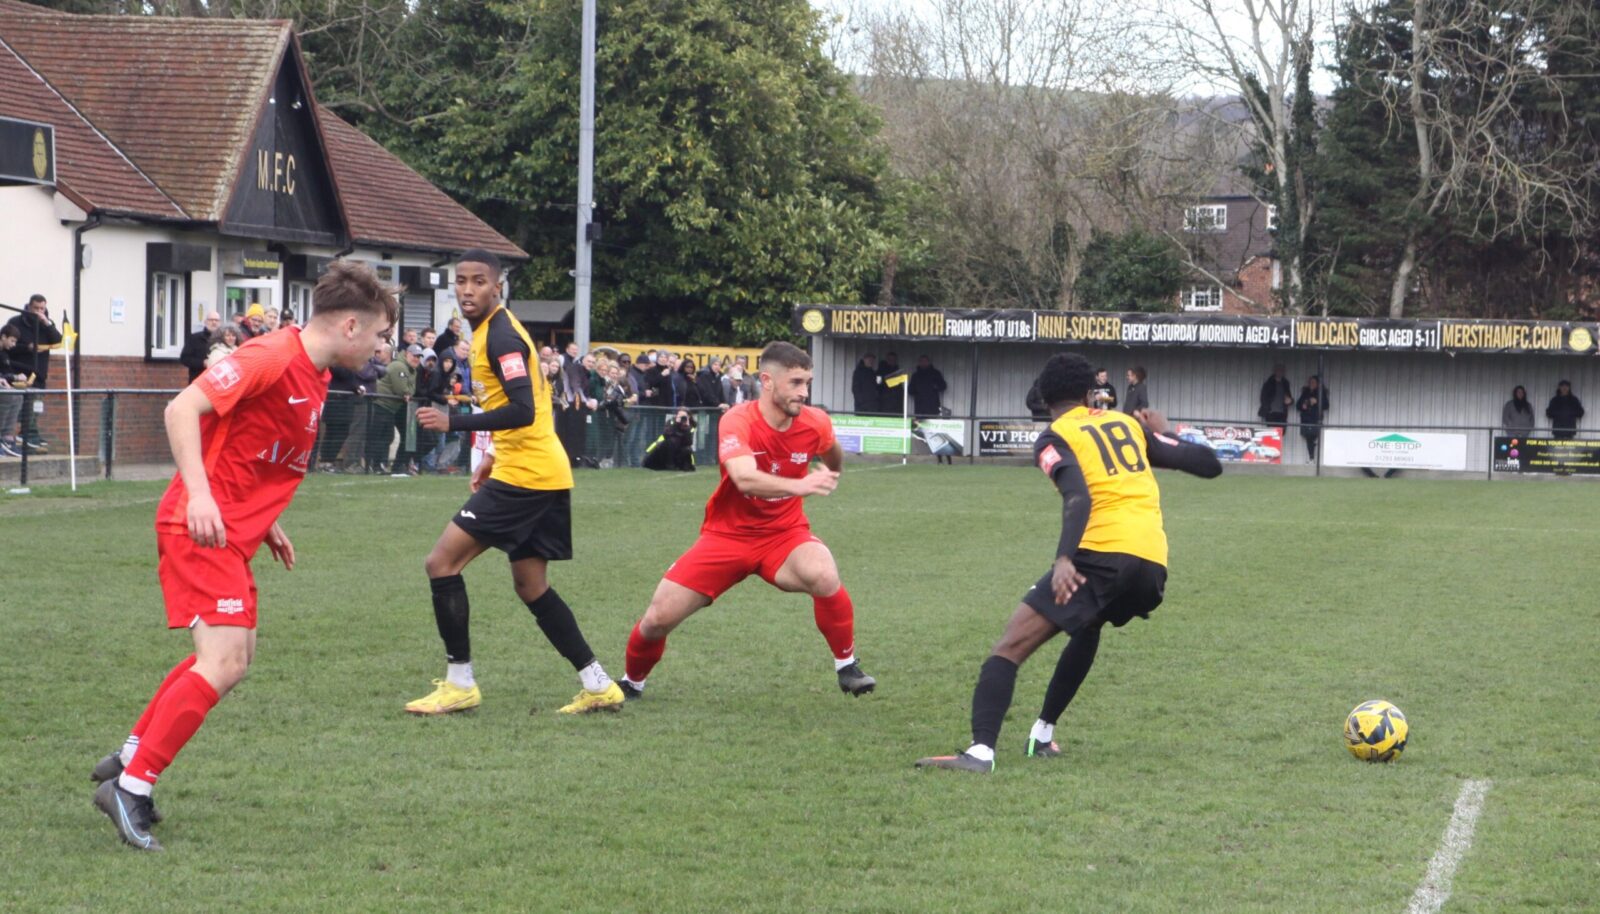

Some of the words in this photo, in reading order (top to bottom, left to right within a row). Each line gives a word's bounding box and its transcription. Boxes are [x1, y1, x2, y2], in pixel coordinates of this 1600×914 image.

[831, 310, 900, 334] MERSTHAM
[904, 313, 944, 336] YOUTH
[946, 319, 973, 337] FROM
[975, 320, 992, 337] U8s
[993, 320, 1006, 337] TO
[1008, 320, 1031, 338] U18s
[1037, 315, 1121, 341] MINI-SOCCER
[1122, 323, 1150, 341] EVERY
[1151, 323, 1198, 342] SATURDAY
[1199, 325, 1244, 343] MORNING
[1246, 326, 1270, 344] AGED
[1271, 327, 1290, 344] 4+
[1296, 322, 1359, 345] WILDCATS
[1359, 328, 1387, 346] GIRLS
[1388, 329, 1413, 346] AGED
[1415, 329, 1436, 347] 5-11
[1442, 324, 1562, 350] MERSTHAMFC.COM
[980, 430, 1007, 443] VJT
[1010, 431, 1041, 443] PHO
[1079, 420, 1146, 476] 18
